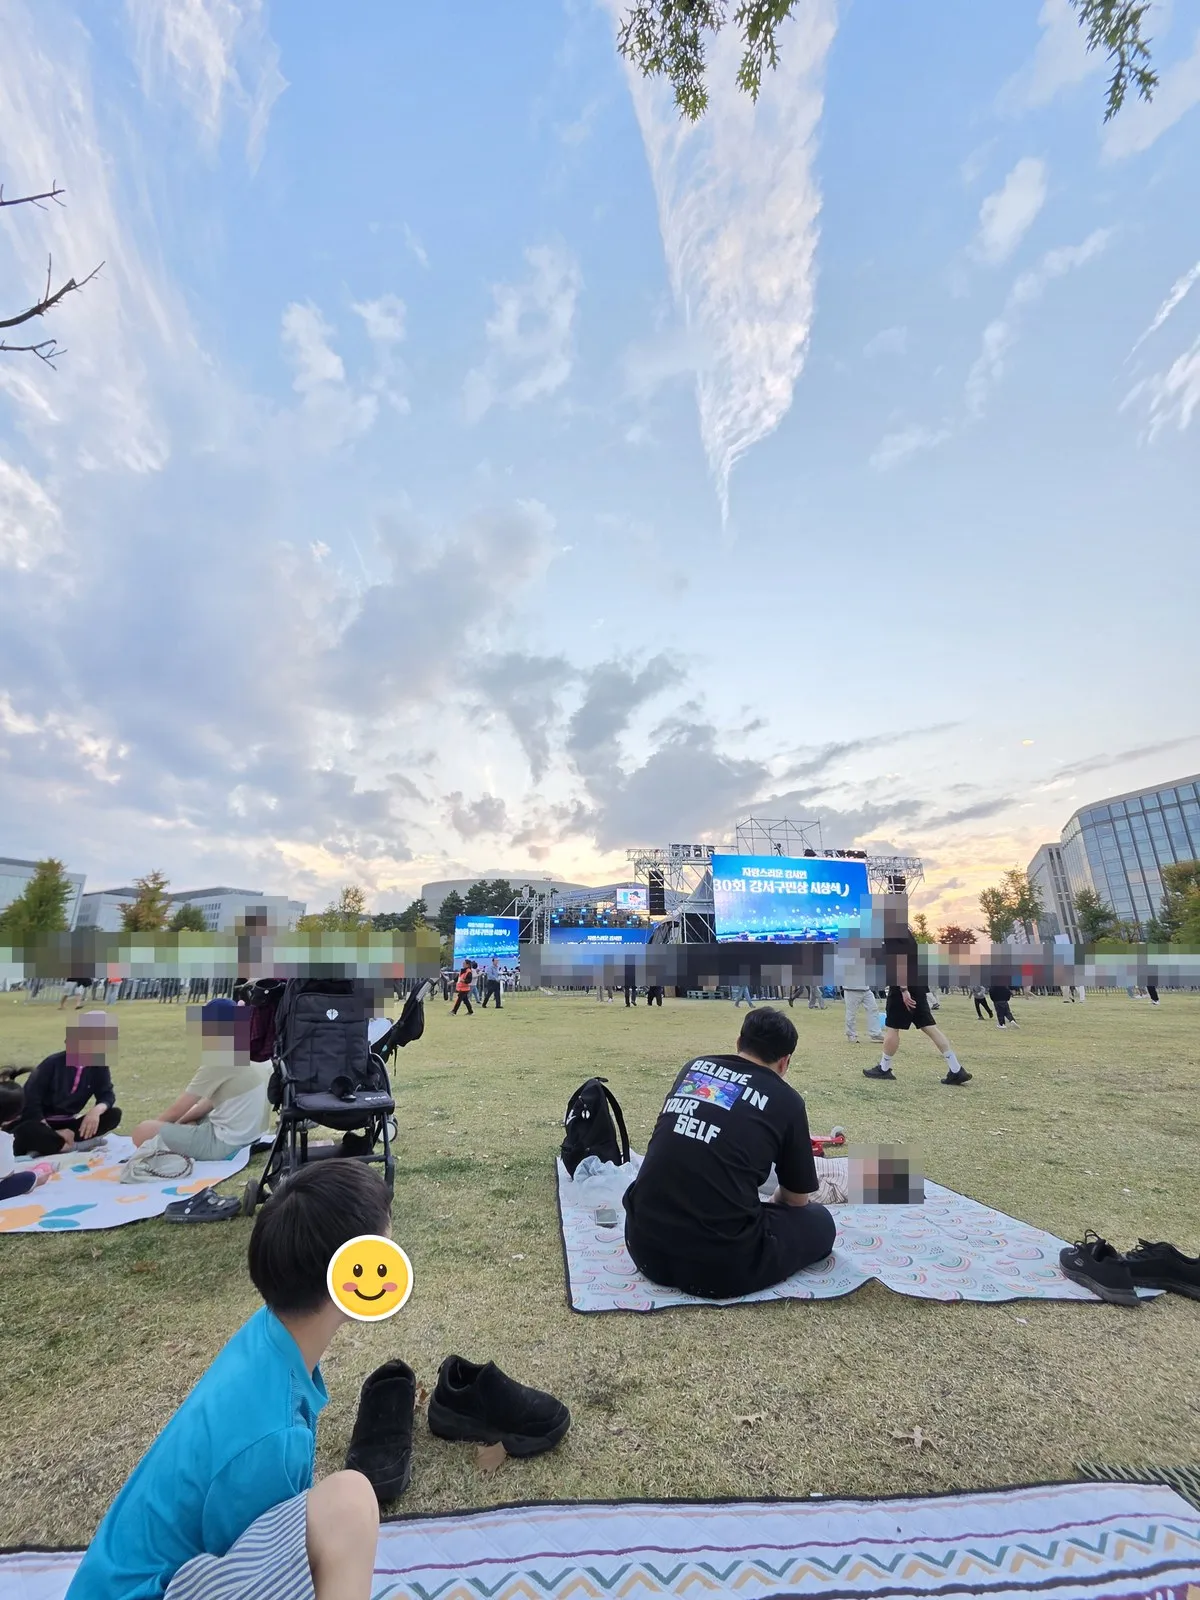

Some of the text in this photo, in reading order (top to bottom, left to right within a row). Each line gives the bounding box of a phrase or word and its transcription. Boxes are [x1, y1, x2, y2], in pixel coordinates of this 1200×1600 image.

[742, 867, 784, 878] 자랑스러운
[713, 878, 841, 895] 30회 강서구민상 시상식
[690, 1060, 752, 1086] BELIEVE
[662, 1097, 700, 1117] YOUR
[741, 1086, 769, 1111] IN
[673, 1115, 721, 1144] SELF
